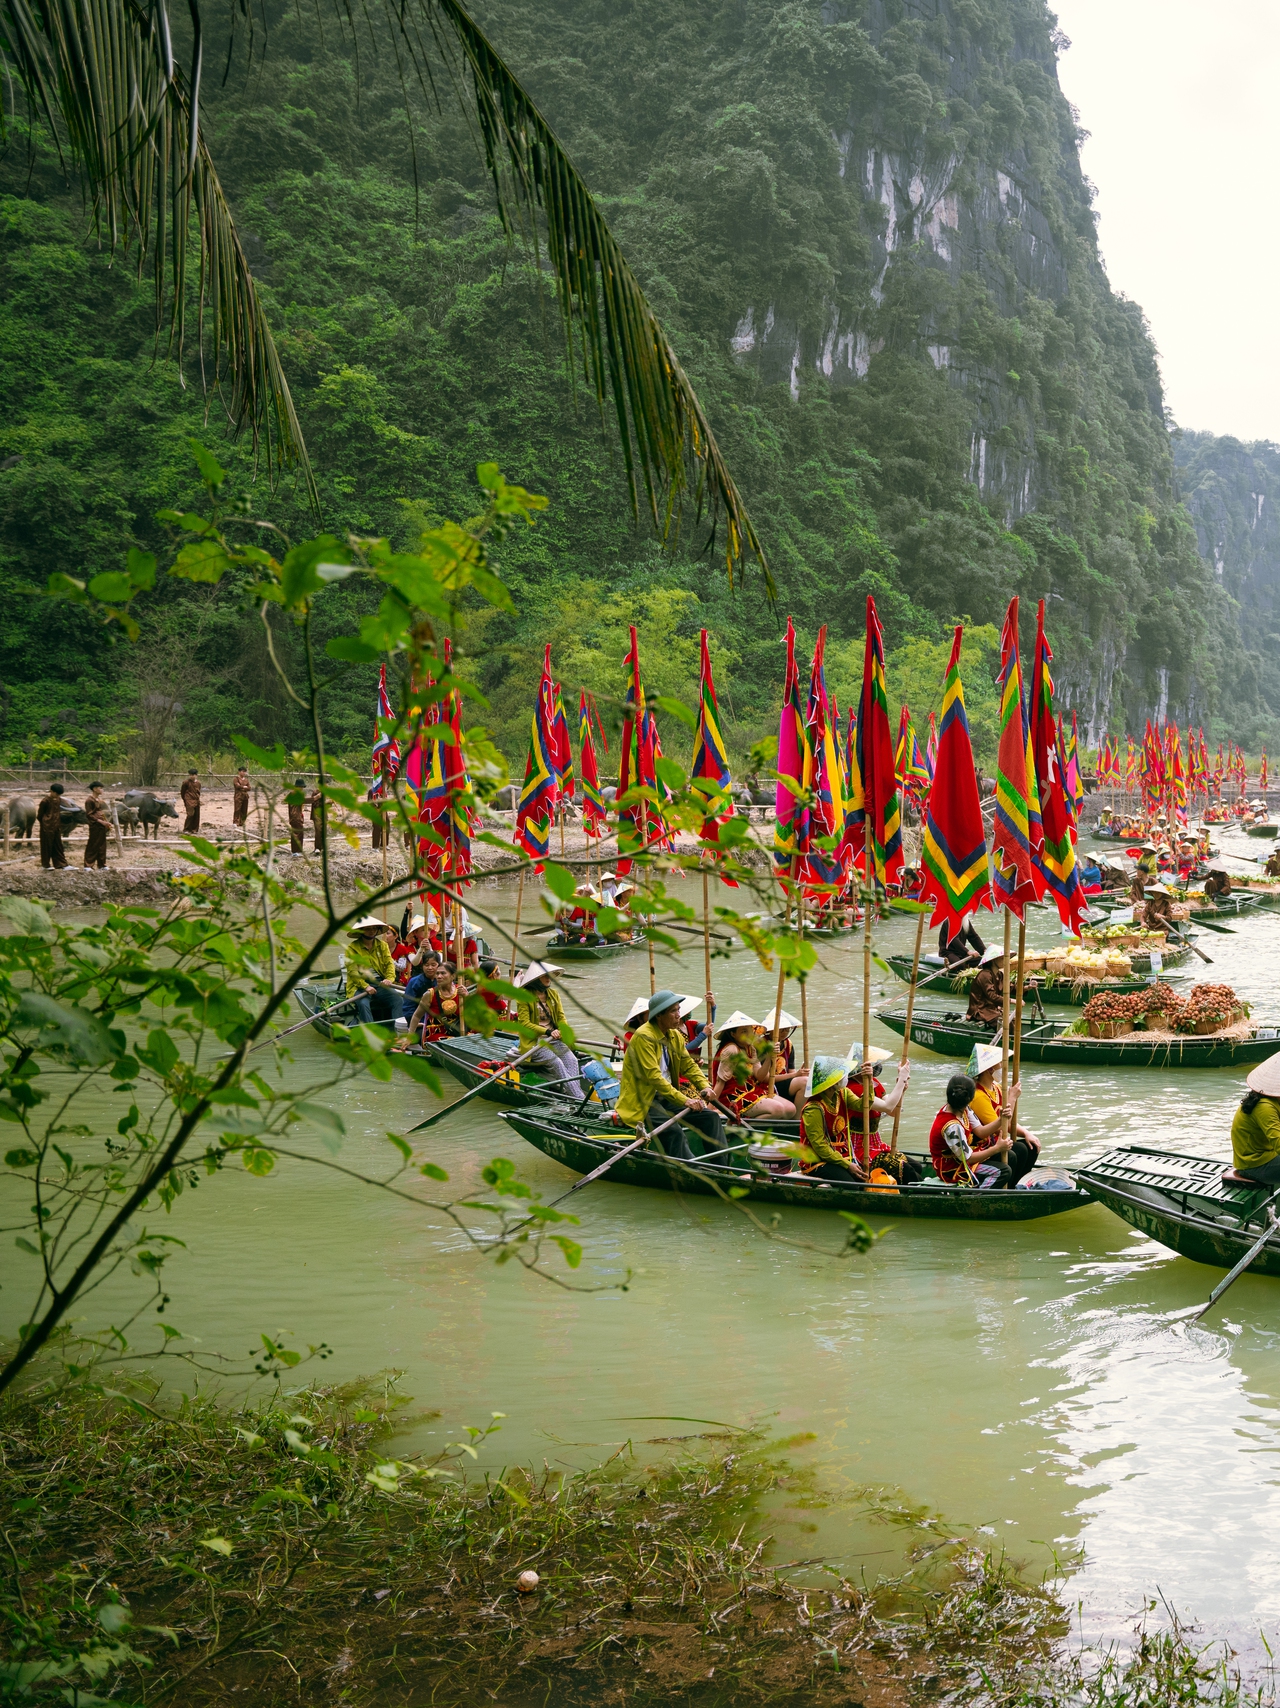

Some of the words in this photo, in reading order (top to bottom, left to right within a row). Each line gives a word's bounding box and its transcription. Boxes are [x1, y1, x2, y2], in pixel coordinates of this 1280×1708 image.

[915, 1029, 934, 1045] 926
[543, 1136, 567, 1158] 333
[1122, 1204, 1158, 1232] 397
